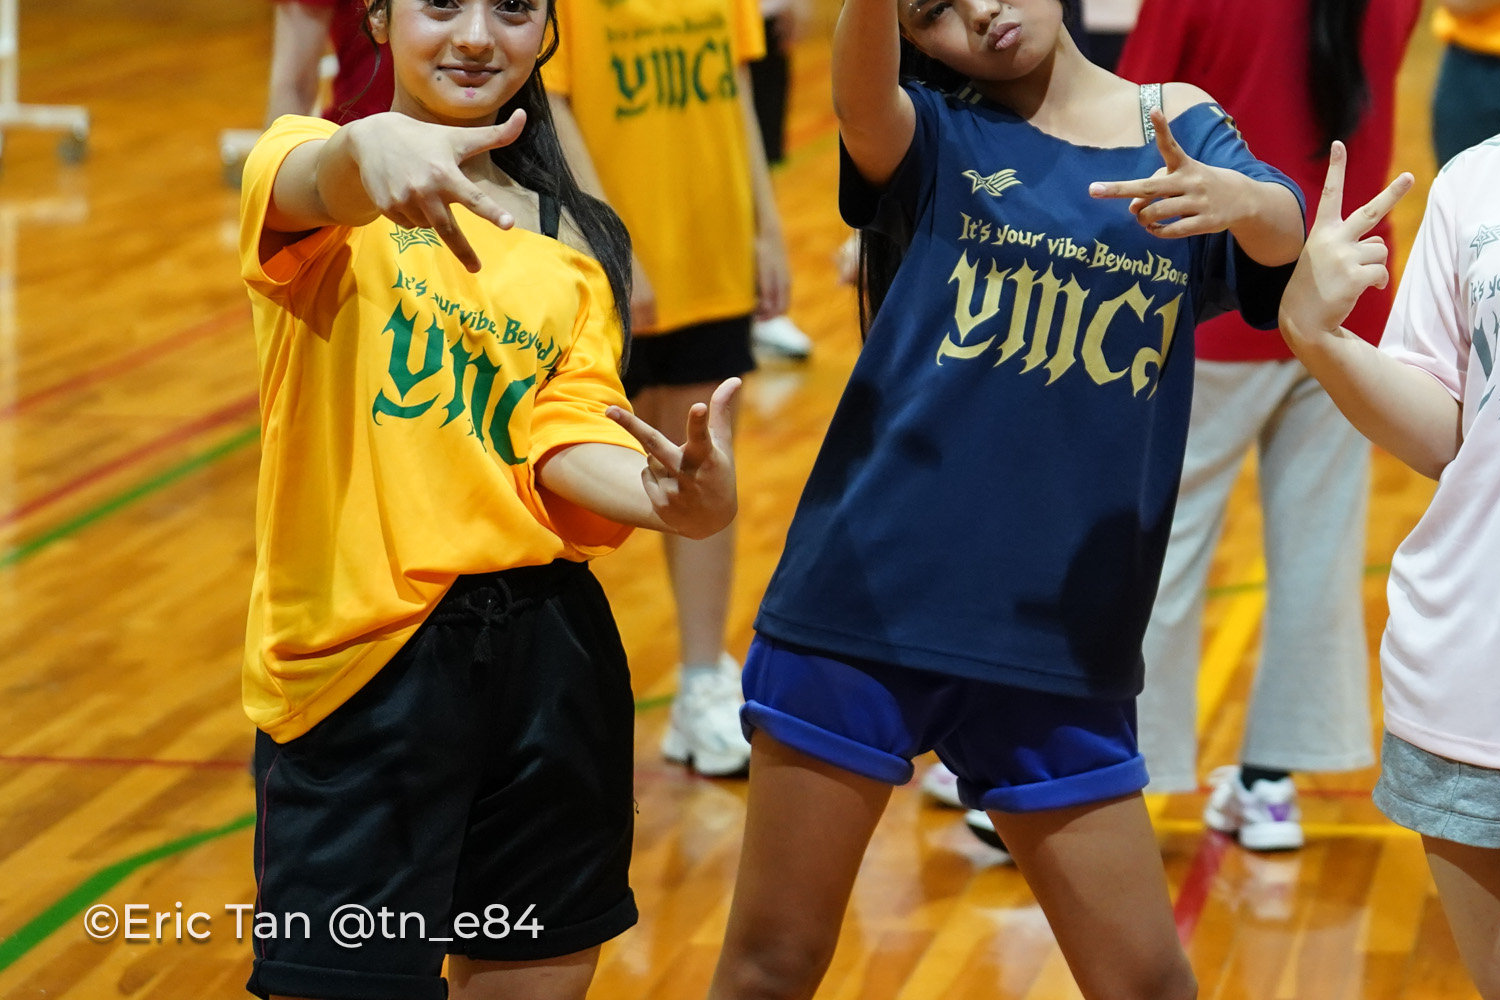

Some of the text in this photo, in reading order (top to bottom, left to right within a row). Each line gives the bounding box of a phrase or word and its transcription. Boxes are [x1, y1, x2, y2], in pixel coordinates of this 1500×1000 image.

[959, 212, 992, 241] It's
[991, 224, 1046, 248] your
[1048, 237, 1090, 263] vibe.
[1087, 239, 1154, 276] Beyond
